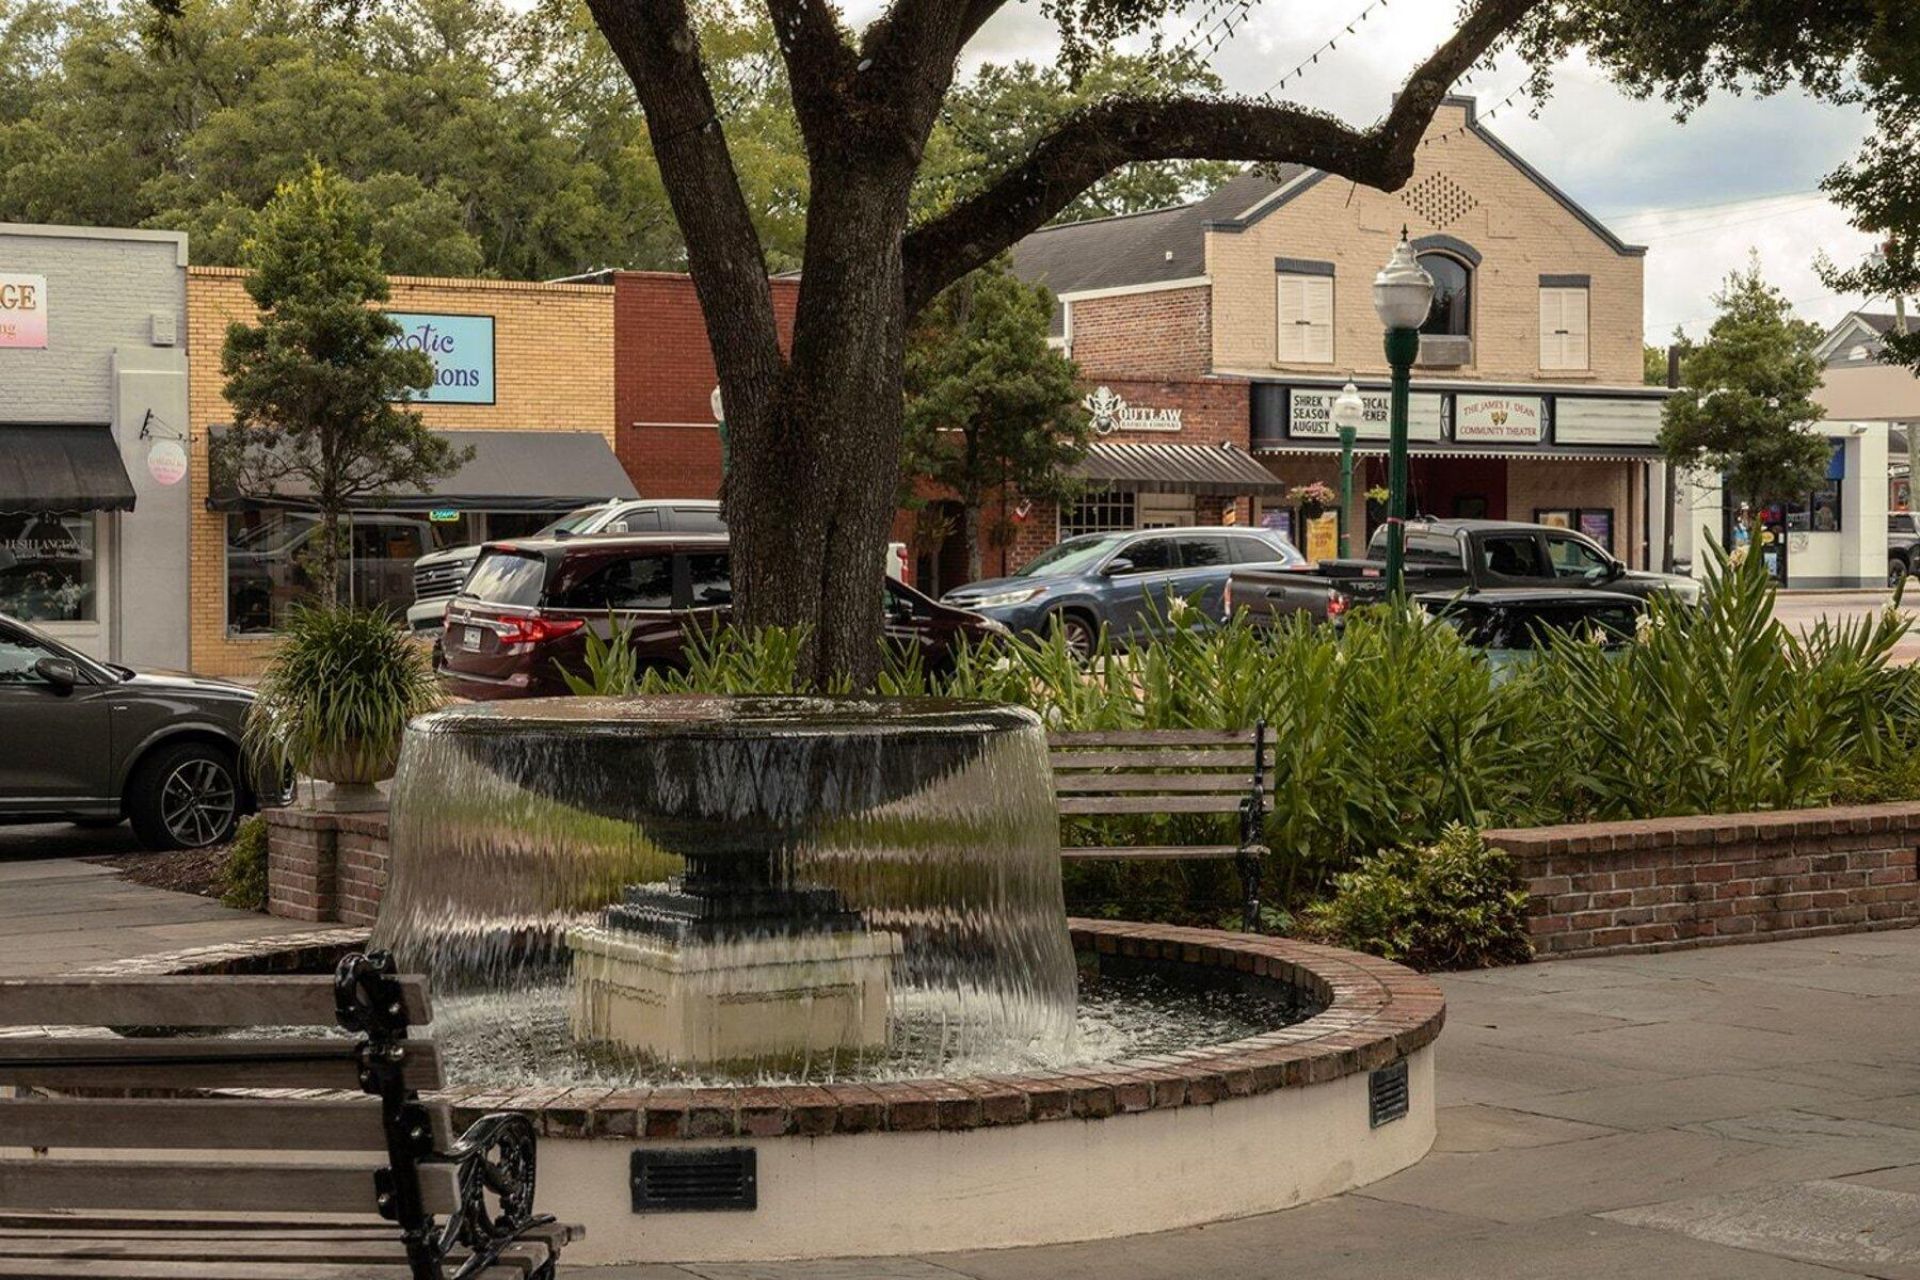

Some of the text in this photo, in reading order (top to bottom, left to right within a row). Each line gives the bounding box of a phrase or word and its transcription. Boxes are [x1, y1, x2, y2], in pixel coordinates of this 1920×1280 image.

[390, 323, 455, 354] xotic
[433, 360, 480, 387] ions
[1294, 395, 1322, 407] SHREK
[1363, 398, 1389, 410] SICAL
[1463, 403, 1479, 416] THE
[1479, 399, 1504, 414] JAMES
[1119, 407, 1182, 421] OUTLAW
[1293, 408, 1388, 421] SEASON PENER
[1292, 421, 1330, 433] AUGUST
[1459, 425, 1537, 437] COMMUNITY THEATER
